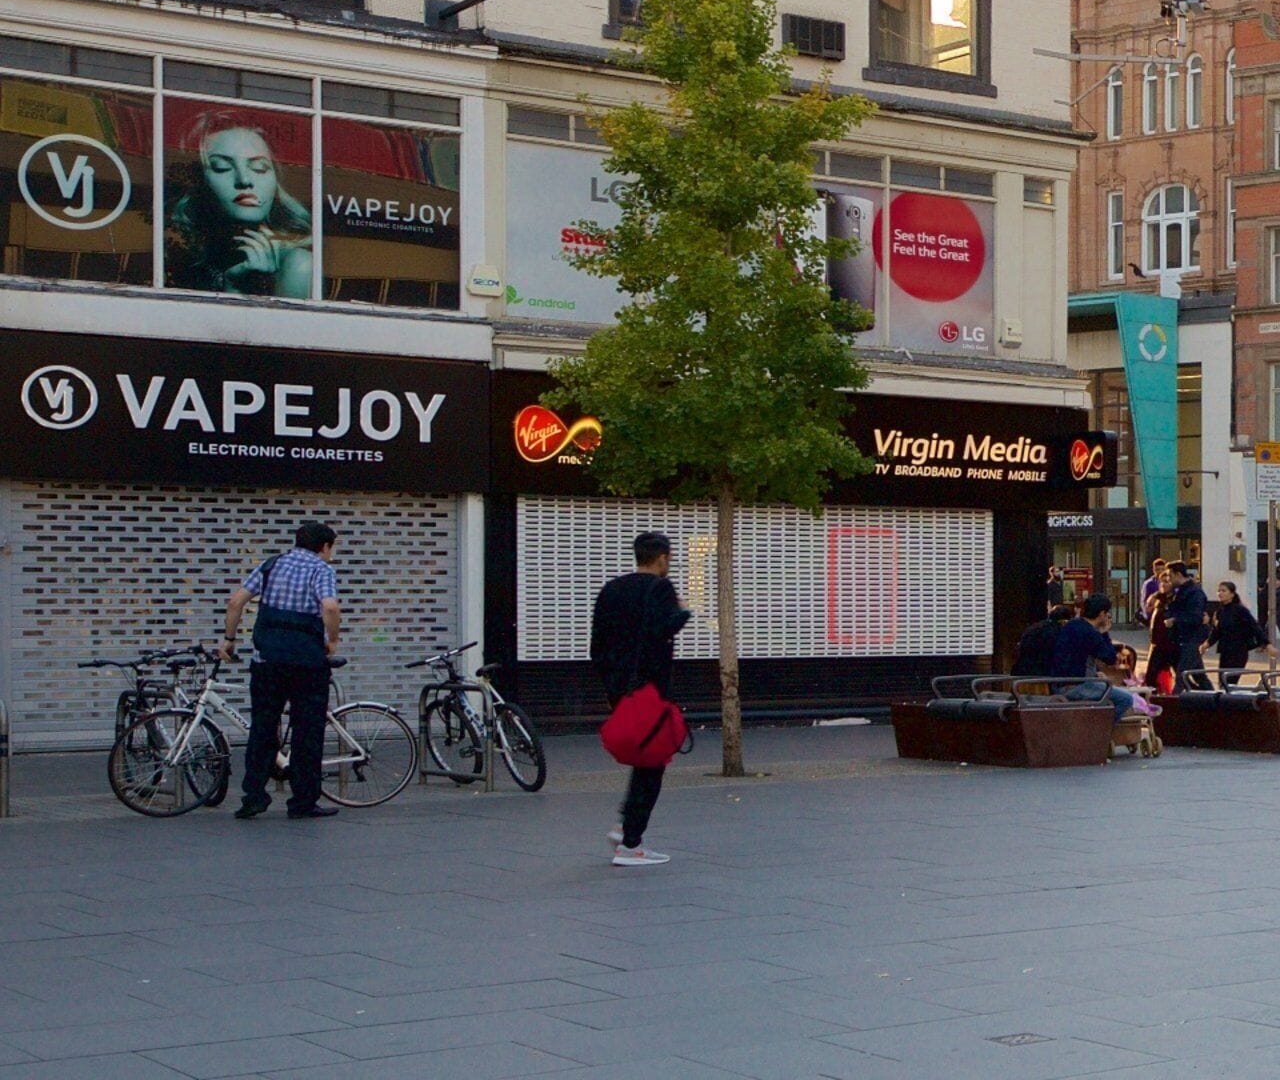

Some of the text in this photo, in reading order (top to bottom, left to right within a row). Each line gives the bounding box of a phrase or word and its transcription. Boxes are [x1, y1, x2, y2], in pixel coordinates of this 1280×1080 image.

[327, 194, 452, 226] VAPEJOY
[347, 219, 434, 234] ELECTRONIC CIGARETTES
[894, 229, 968, 248] See the Great
[893, 243, 970, 262] Feel the Great
[528, 297, 576, 310] android
[962, 326, 985, 342] LG
[115, 374, 447, 443] VAPEJOY
[520, 415, 561, 452] Virgin
[188, 442, 384, 462] ELECTRONIC CIGARETTES
[873, 429, 1048, 465] Virgin Media
[875, 464, 1047, 482] TV BROADBAND PHONE MOBILE
